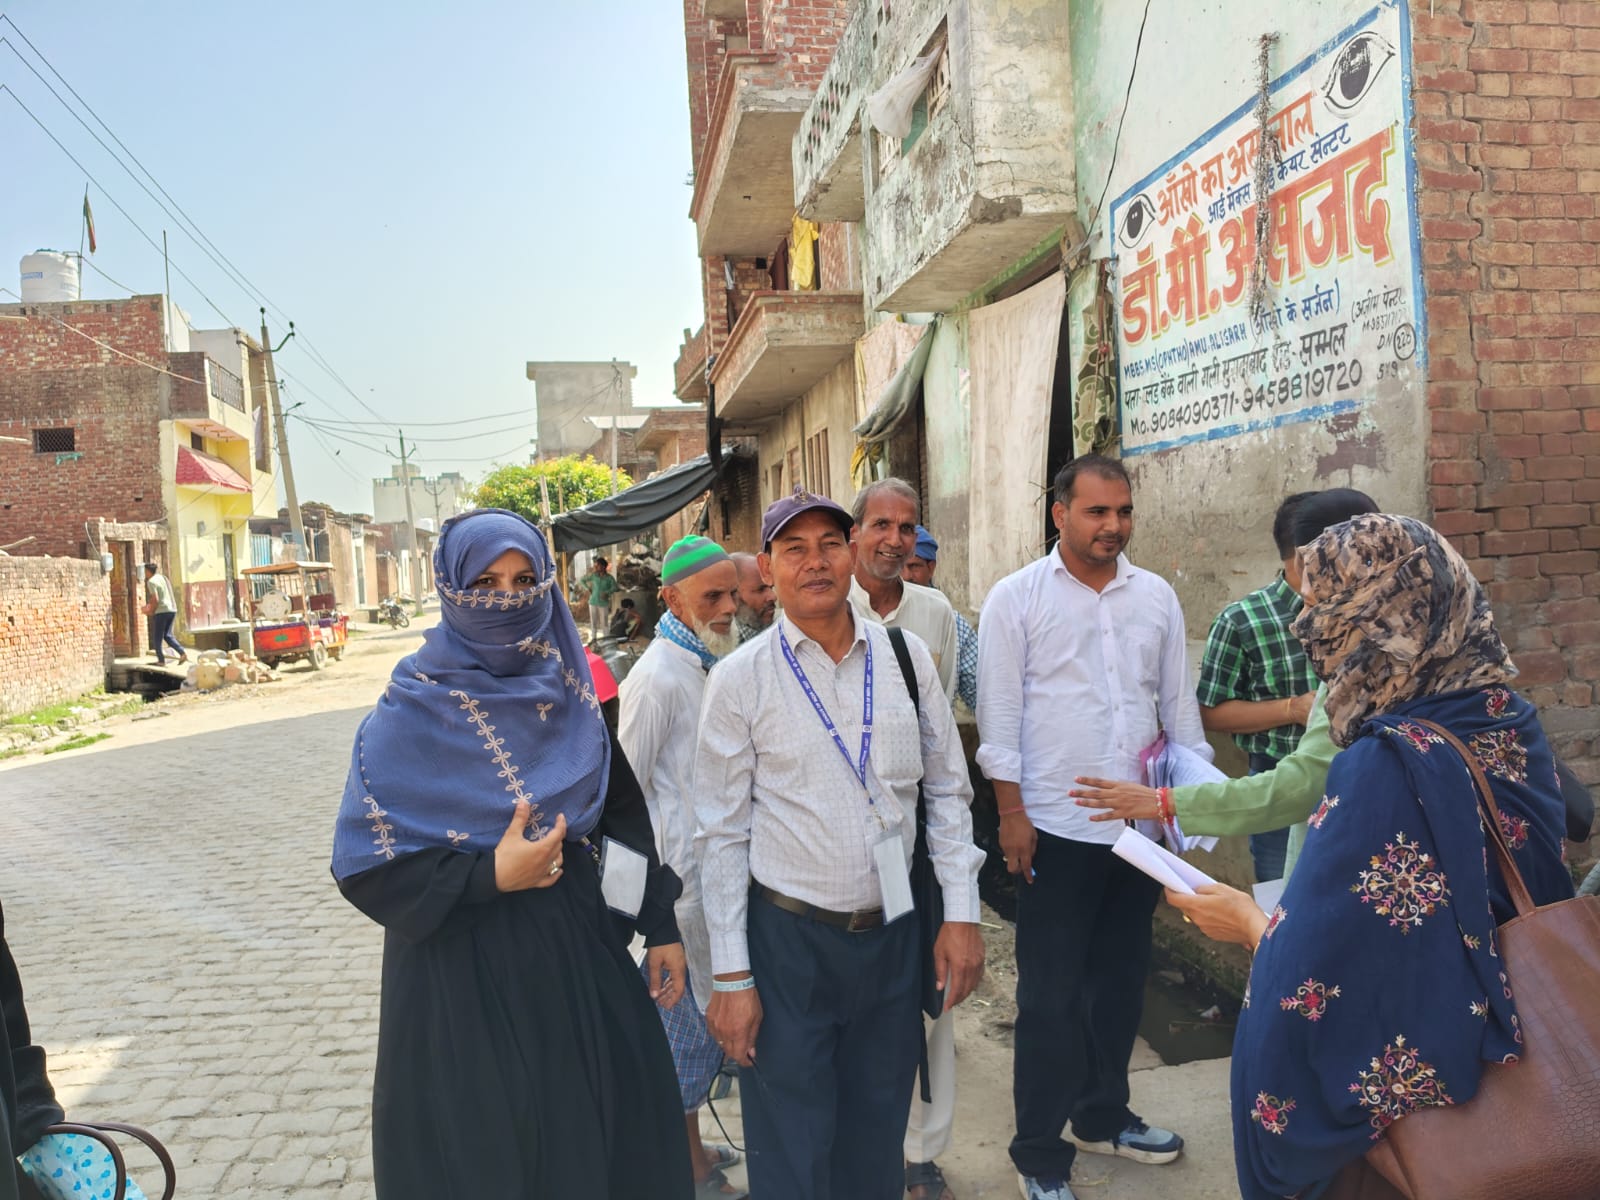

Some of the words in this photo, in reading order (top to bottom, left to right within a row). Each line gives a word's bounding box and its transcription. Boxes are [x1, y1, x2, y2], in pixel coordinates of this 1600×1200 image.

[1200, 151, 1224, 197] का
[1208, 192, 1226, 223] आई
[1285, 297, 1297, 322] के
[1178, 362, 1199, 396] वाली
[1201, 355, 1221, 389] गली
